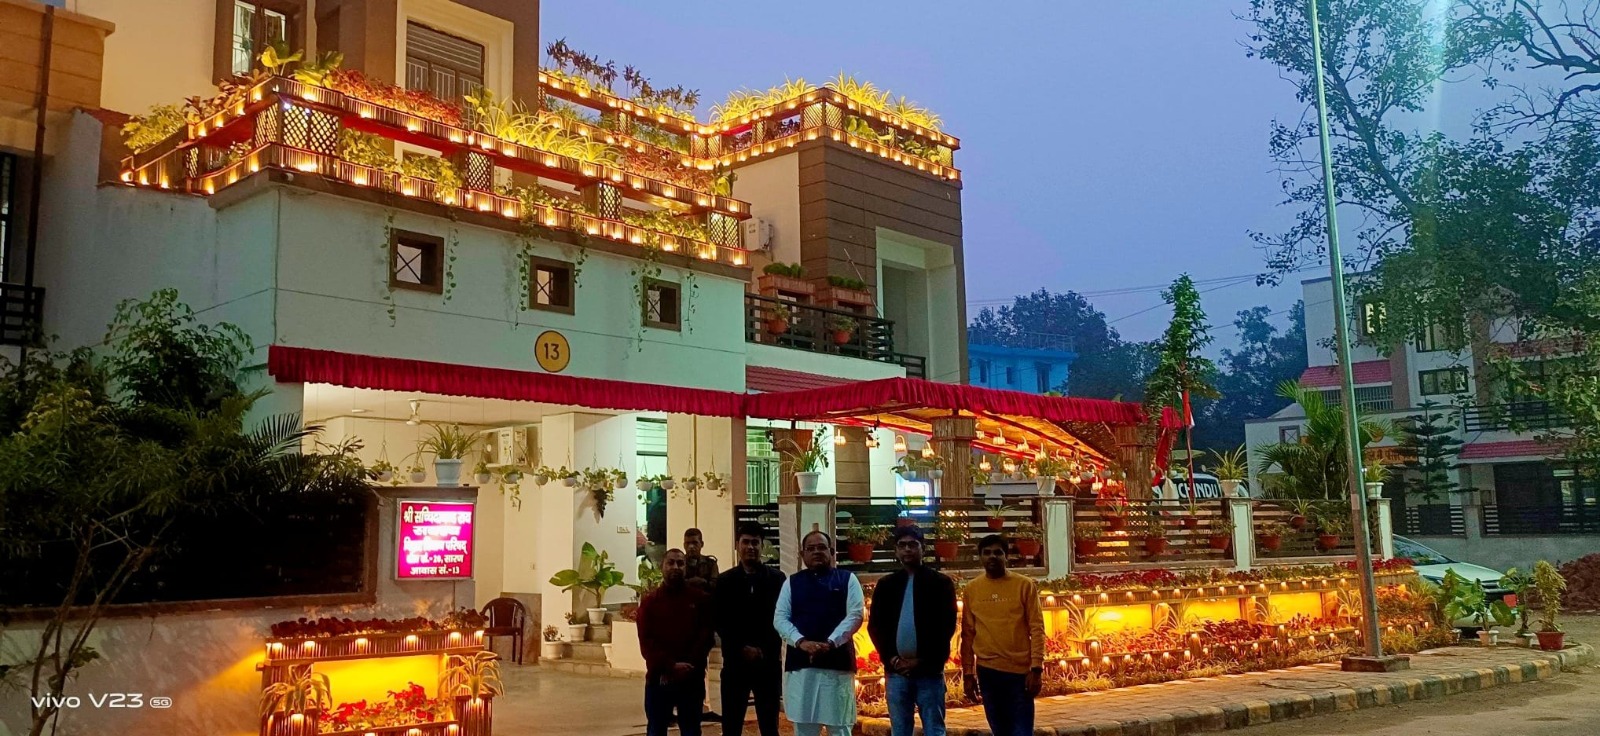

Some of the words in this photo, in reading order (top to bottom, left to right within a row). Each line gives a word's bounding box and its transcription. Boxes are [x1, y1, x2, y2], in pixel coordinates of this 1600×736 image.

[543, 342, 560, 361] 13
[404, 505, 414, 524] श्री
[410, 566, 437, 575] आवास
